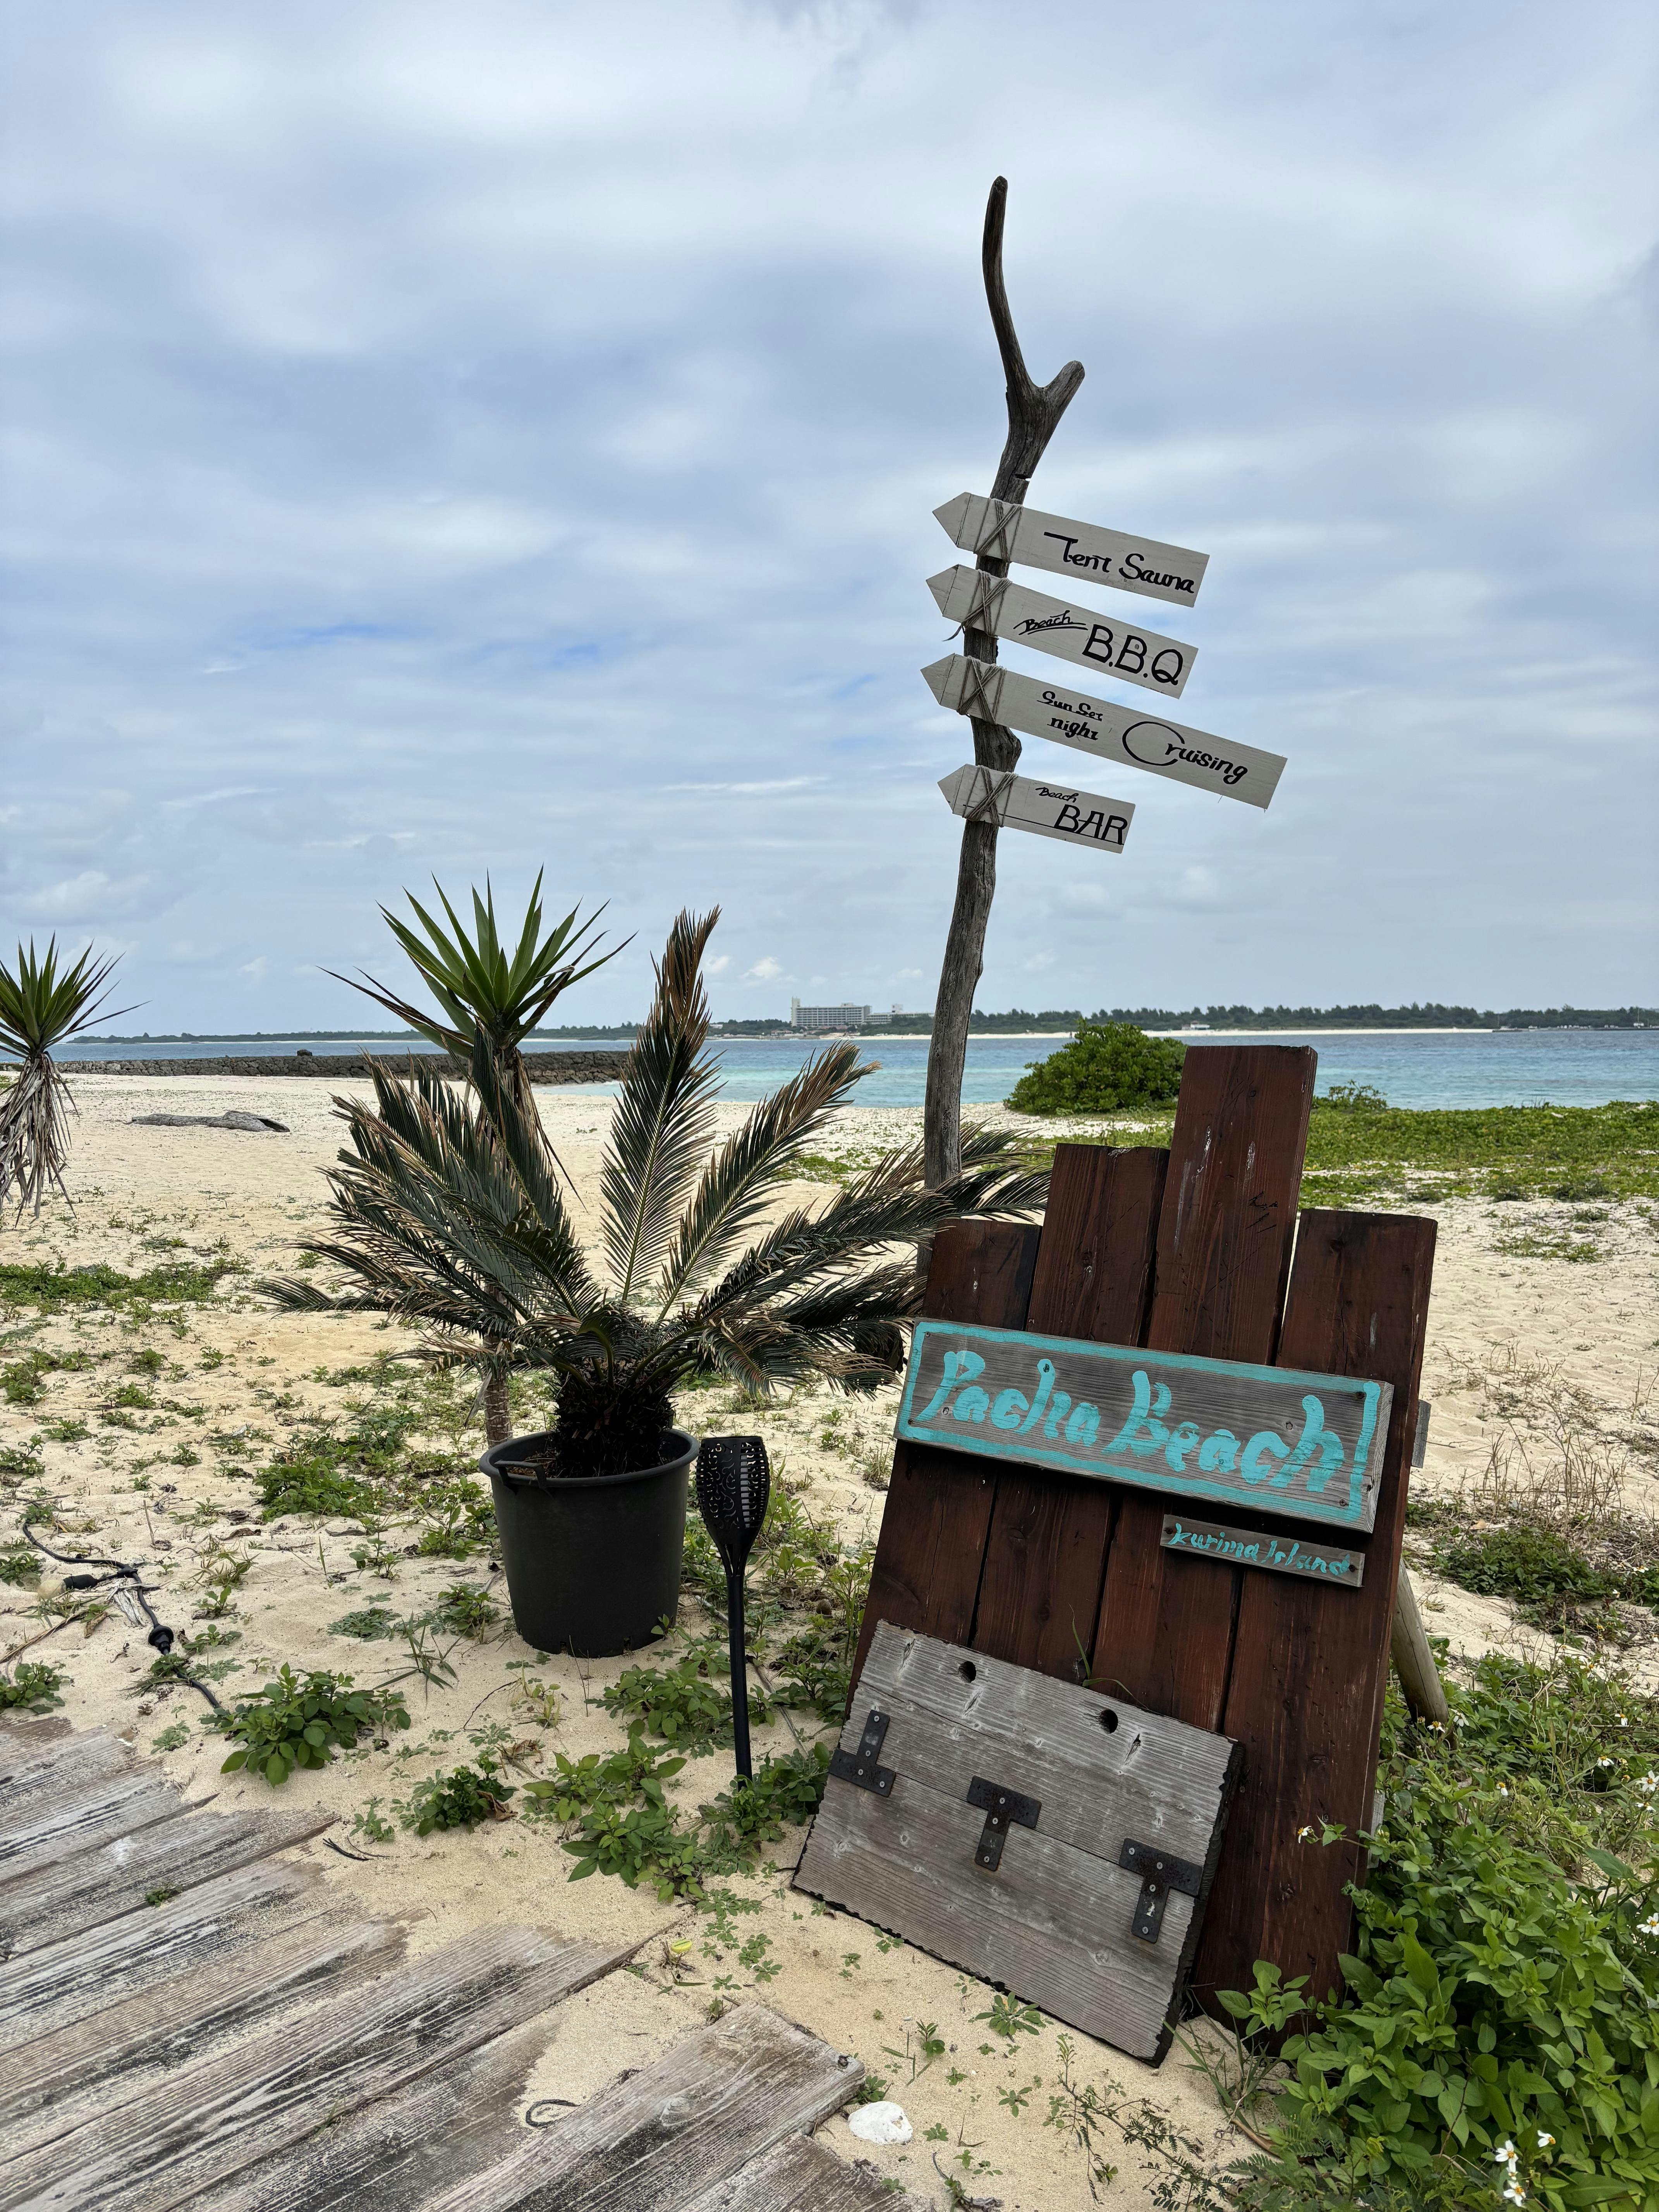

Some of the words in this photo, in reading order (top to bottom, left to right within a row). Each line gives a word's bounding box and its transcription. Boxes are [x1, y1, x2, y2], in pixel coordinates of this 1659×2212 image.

[1044, 532, 1111, 574] Tent
[1119, 553, 1195, 593] Sauna
[1013, 610, 1087, 635] Beach
[1047, 718, 1099, 740] night
[1122, 721, 1248, 785] Cruising
[1035, 787, 1079, 802] Beach
[1054, 804, 1128, 845] BAR
[1102, 1370, 1345, 1493] Beach
[1261, 1540, 1350, 1575] Island
